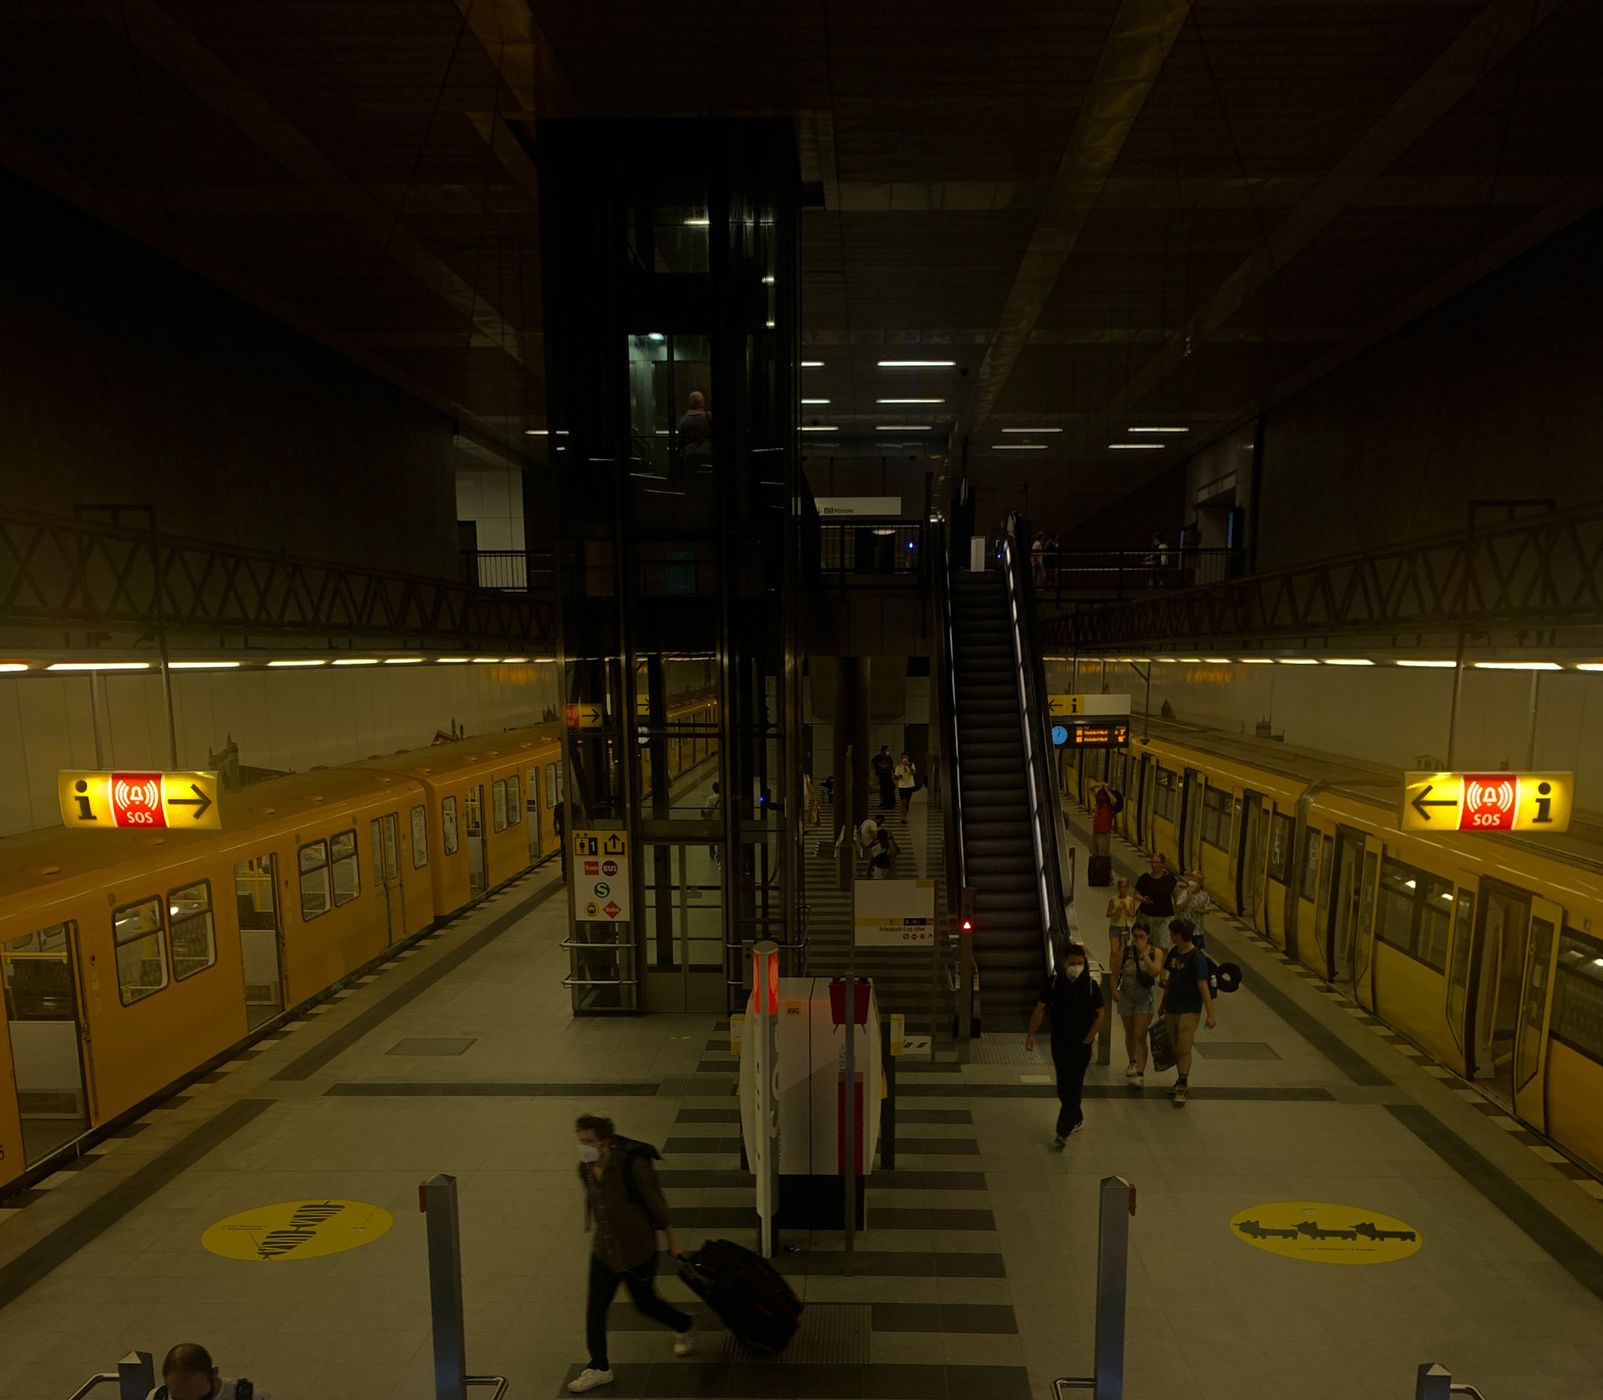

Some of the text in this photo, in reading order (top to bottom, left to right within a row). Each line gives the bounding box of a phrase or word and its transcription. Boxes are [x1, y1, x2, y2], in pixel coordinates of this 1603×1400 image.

[74, 779, 97, 820] i
[1532, 781, 1552, 823] i
[126, 811, 153, 824] SOS
[1472, 813, 1501, 826] SOS
[596, 882, 609, 897] S
